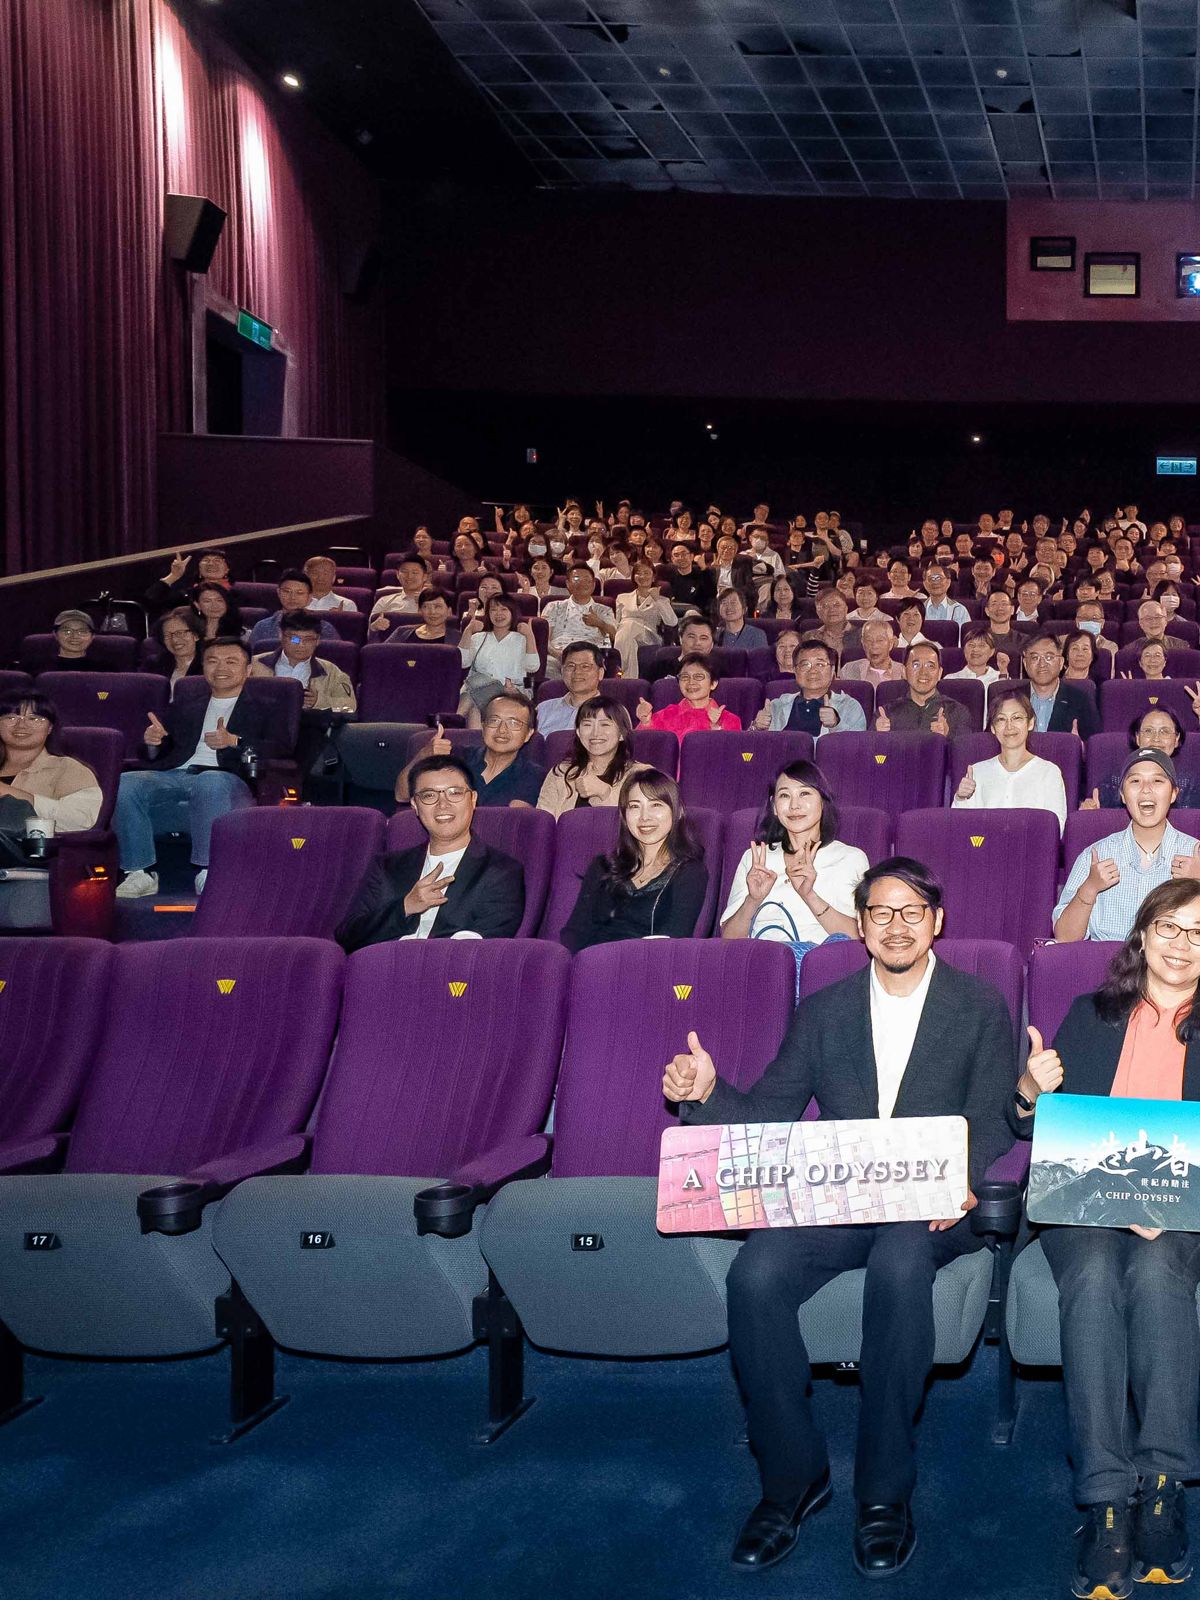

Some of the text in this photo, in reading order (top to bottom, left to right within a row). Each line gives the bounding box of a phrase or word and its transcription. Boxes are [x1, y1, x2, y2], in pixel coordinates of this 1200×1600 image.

[1088, 1129, 1190, 1177] 造山者
[682, 1158, 949, 1190] A CHIP ODYSSEY
[1095, 1191, 1181, 1203] A CHIP ODYSSEY
[32, 1235, 48, 1246] 17
[307, 1234, 323, 1244] 16
[578, 1236, 593, 1246] 15
